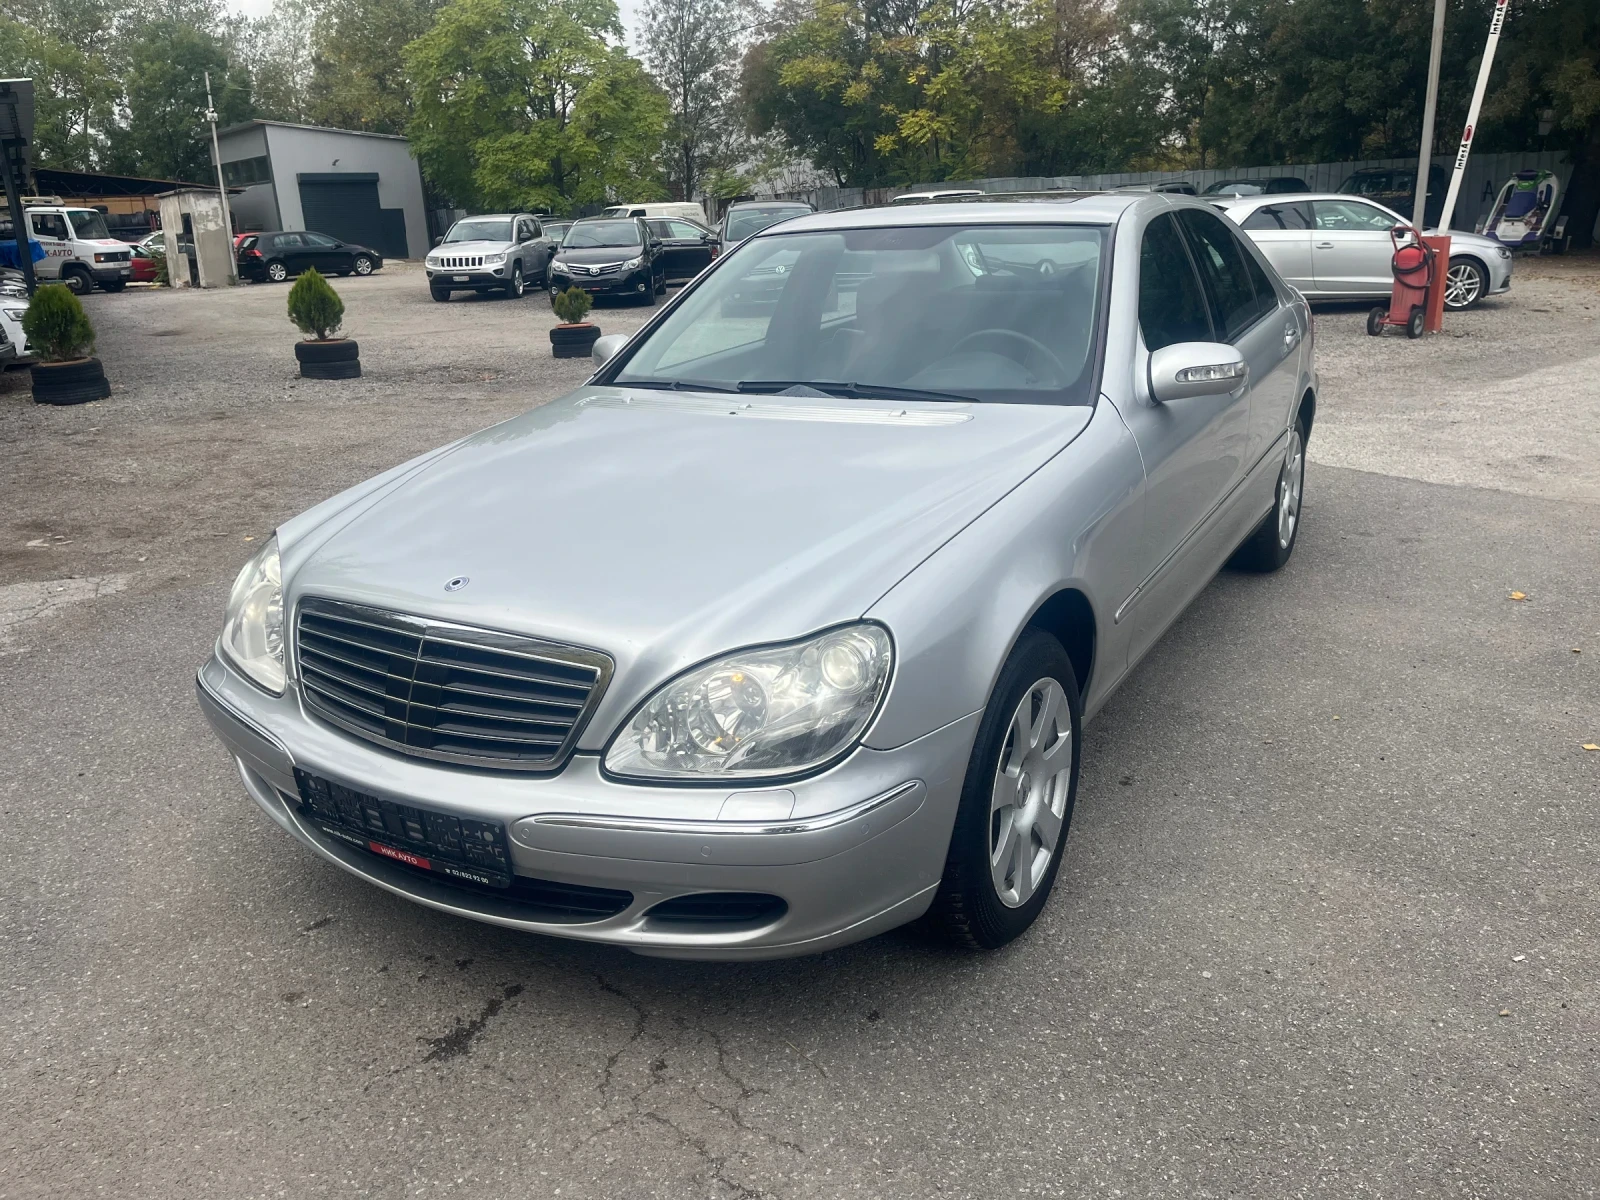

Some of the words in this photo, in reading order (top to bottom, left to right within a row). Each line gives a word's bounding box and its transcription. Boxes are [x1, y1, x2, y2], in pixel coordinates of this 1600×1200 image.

[1489, 7, 1504, 35] IntesA
[1454, 143, 1469, 170] IntesA
[45, 249, 73, 257] К-АУТО
[381, 847, 398, 859] НИК
[398, 853, 418, 865] АУТО
